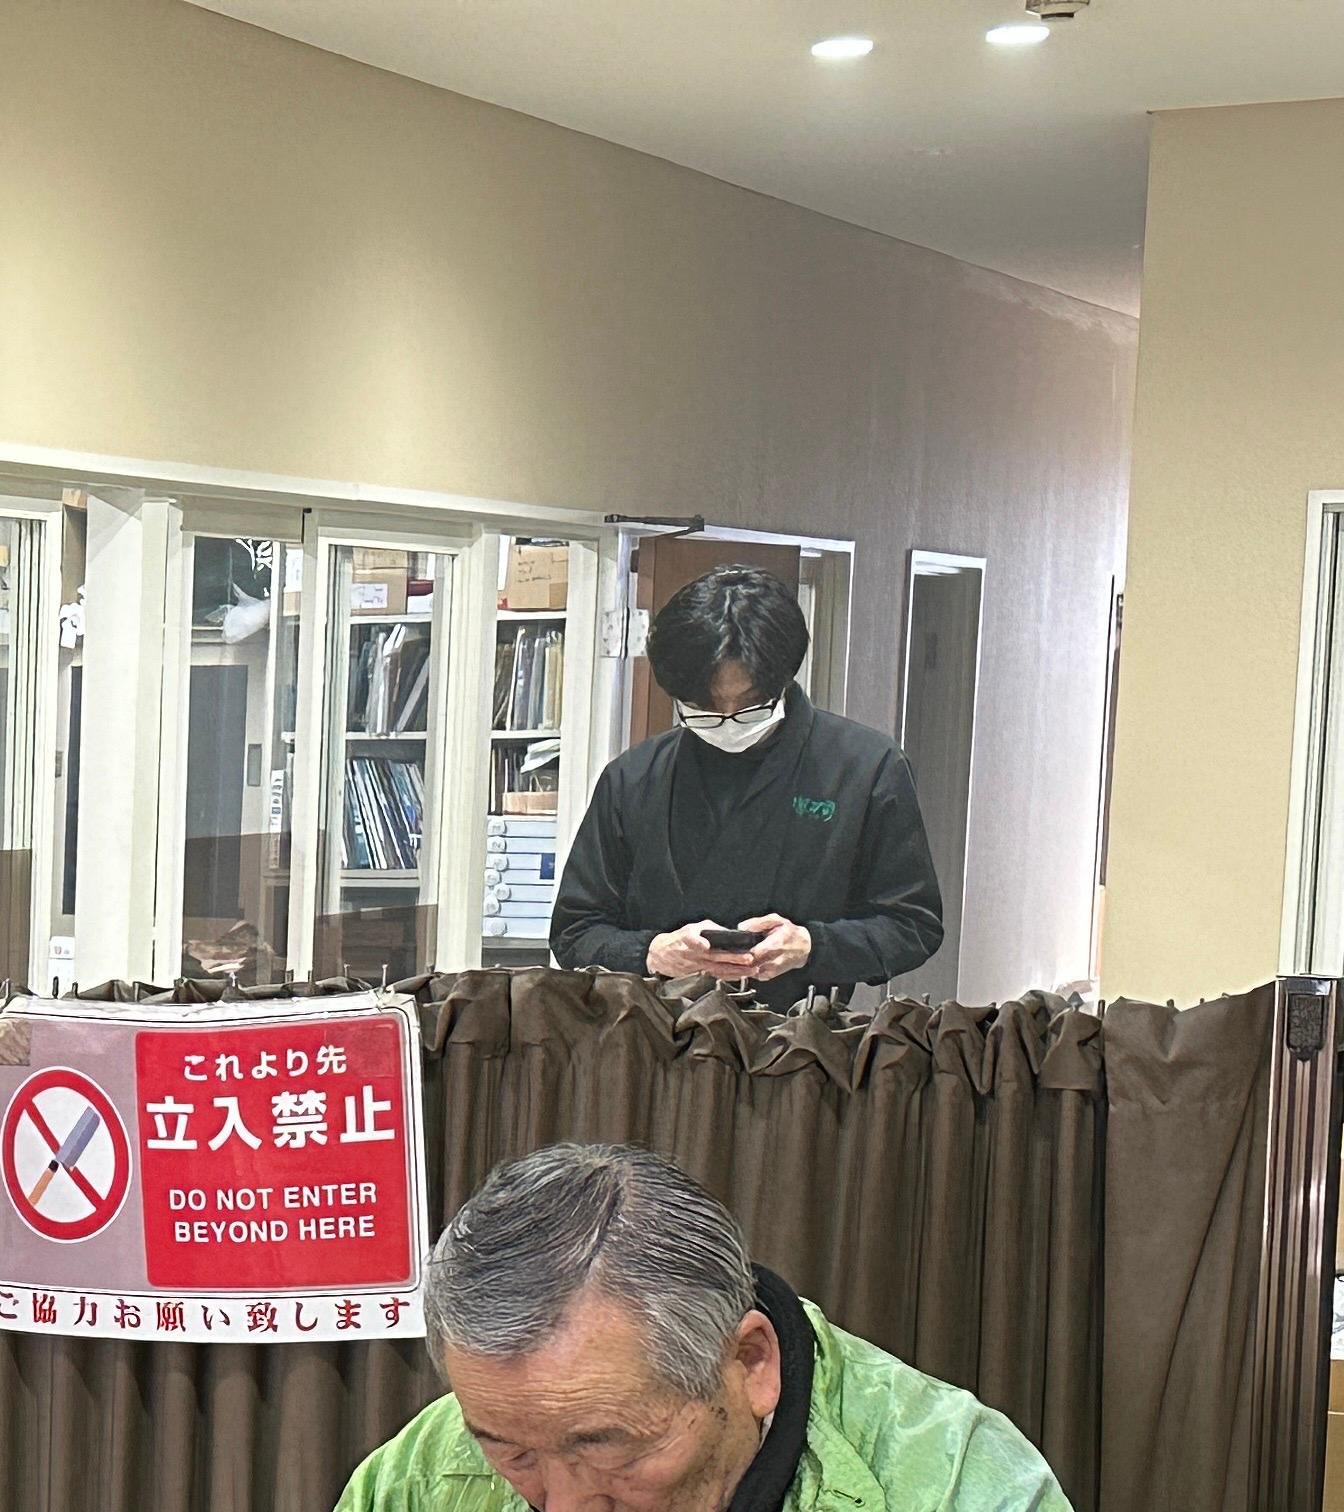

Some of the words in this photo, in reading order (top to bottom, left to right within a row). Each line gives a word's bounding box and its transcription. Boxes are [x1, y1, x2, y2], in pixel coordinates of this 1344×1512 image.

[184, 1045, 347, 1082] これより先
[146, 1085, 395, 1151] 立入禁止
[169, 1188, 207, 1211] DO
[216, 1187, 273, 1211] NOT
[283, 1182, 377, 1209] ENTER
[174, 1220, 288, 1243] BEYOND
[298, 1215, 376, 1241] HERE
